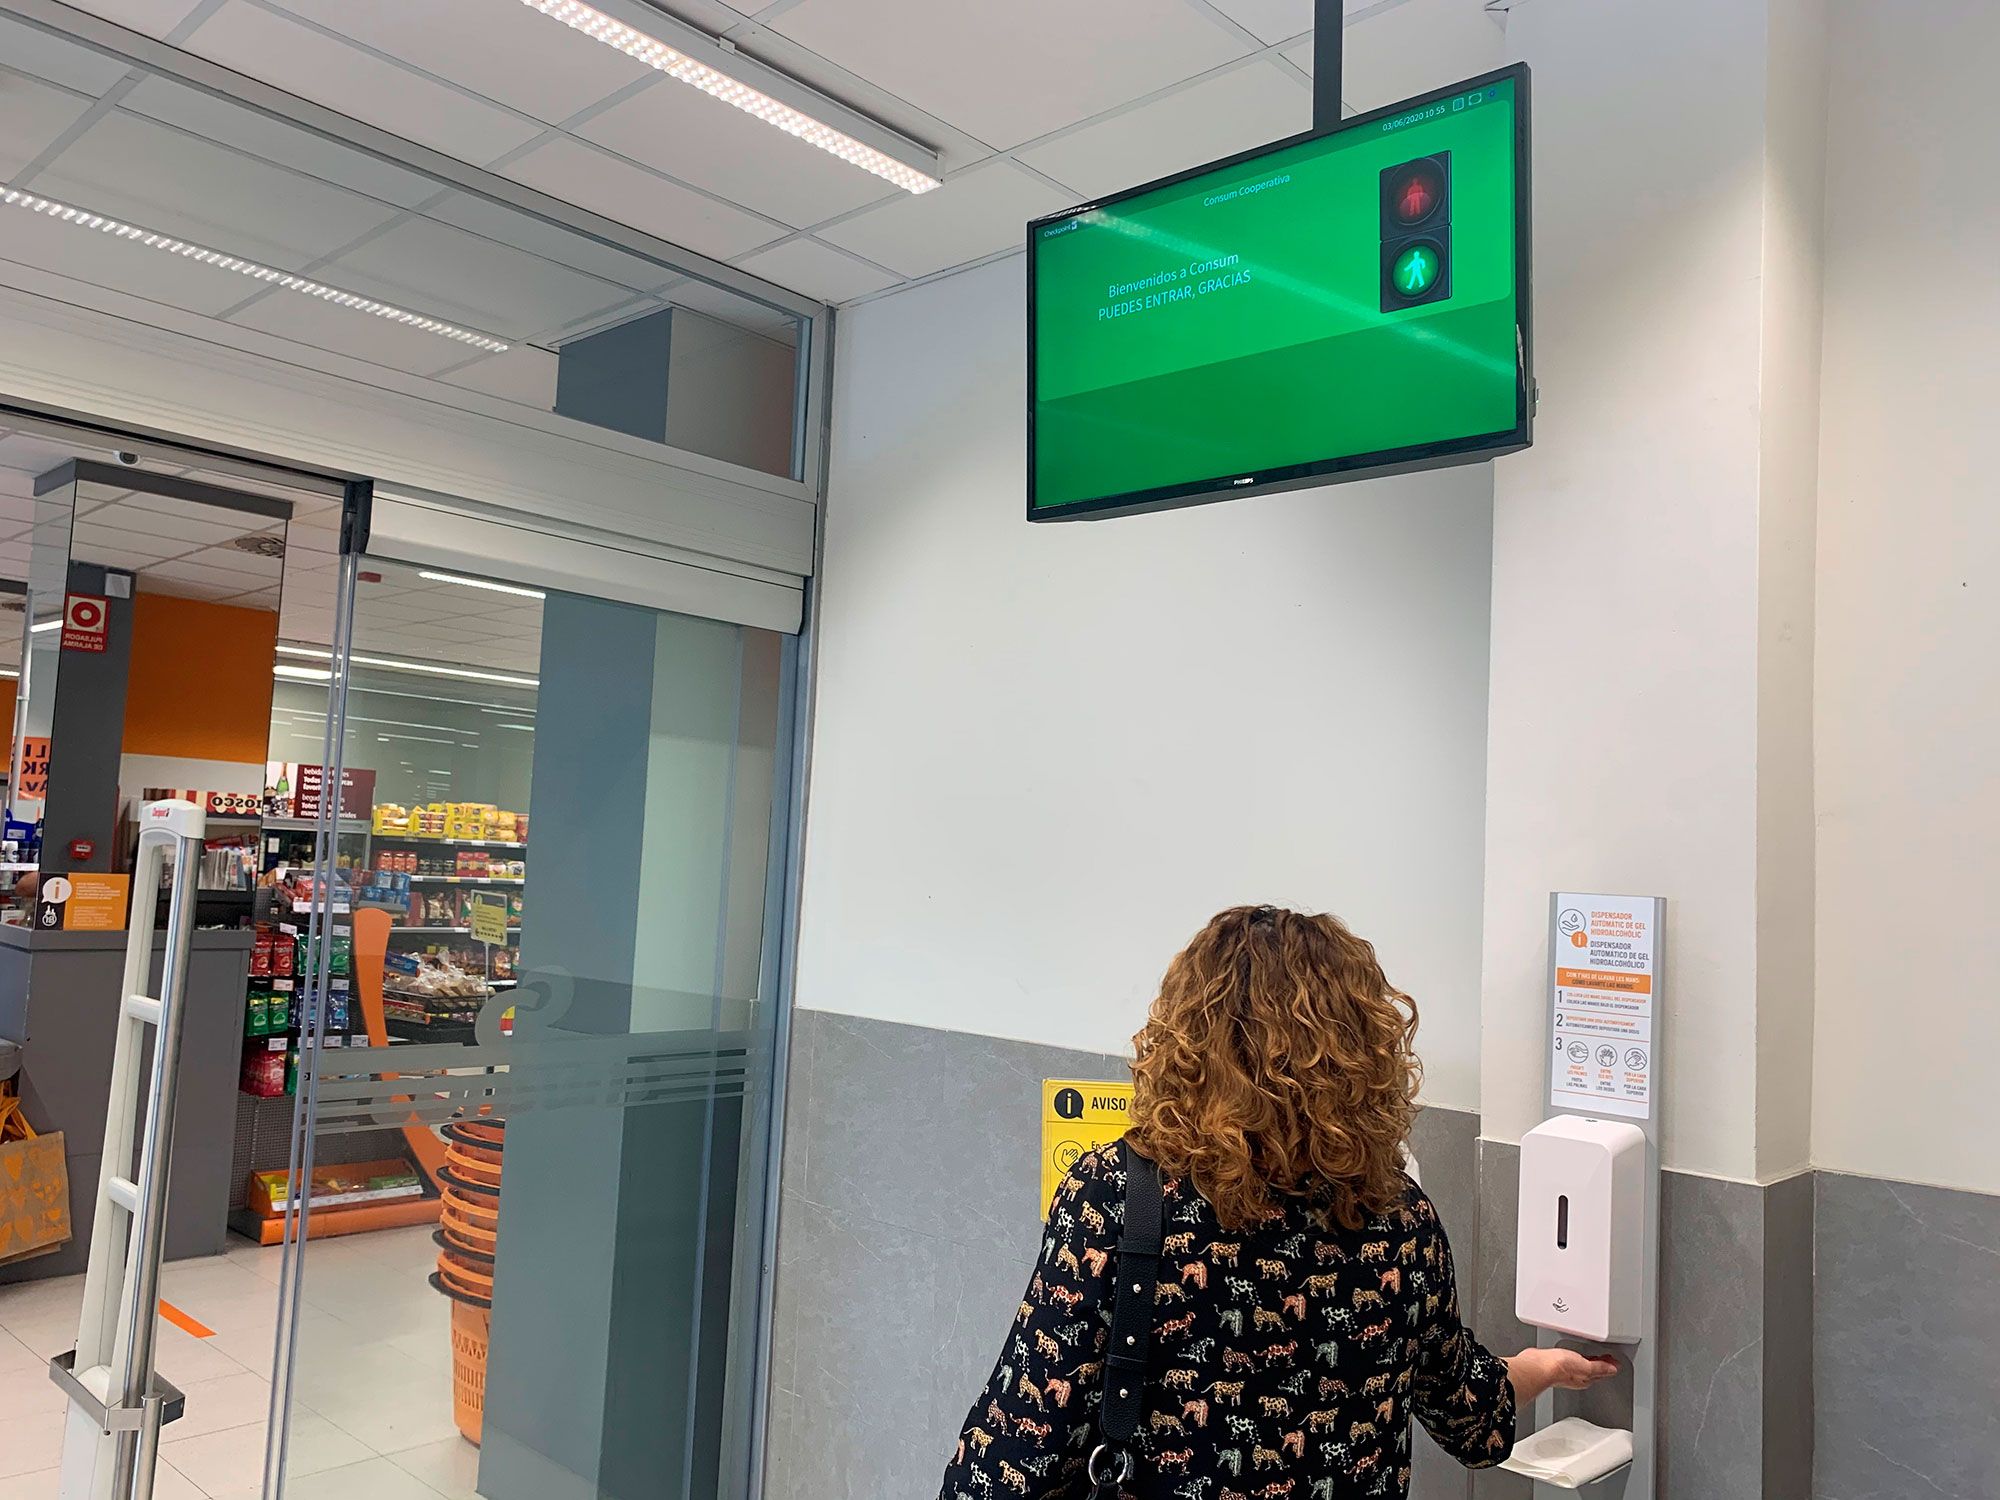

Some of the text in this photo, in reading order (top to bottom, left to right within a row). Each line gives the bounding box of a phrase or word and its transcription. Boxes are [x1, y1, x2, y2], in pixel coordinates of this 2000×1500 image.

[1382, 112, 1424, 131] 03/06/2020
[1203, 174, 1291, 207] Consum Cooperativa
[1108, 254, 1239, 298] Bienvenidos a Consum
[1098, 269, 1251, 321] PUEDES ENTRAR, GRACIAS
[1591, 911, 1632, 919] DISPENSADOR
[1590, 941, 1631, 950] DISPENSADOR
[1557, 990, 1562, 1003] 1
[1556, 1013, 1563, 1026] 2
[1555, 1037, 1562, 1050] 3
[1091, 1097, 1127, 1111] AVISO
